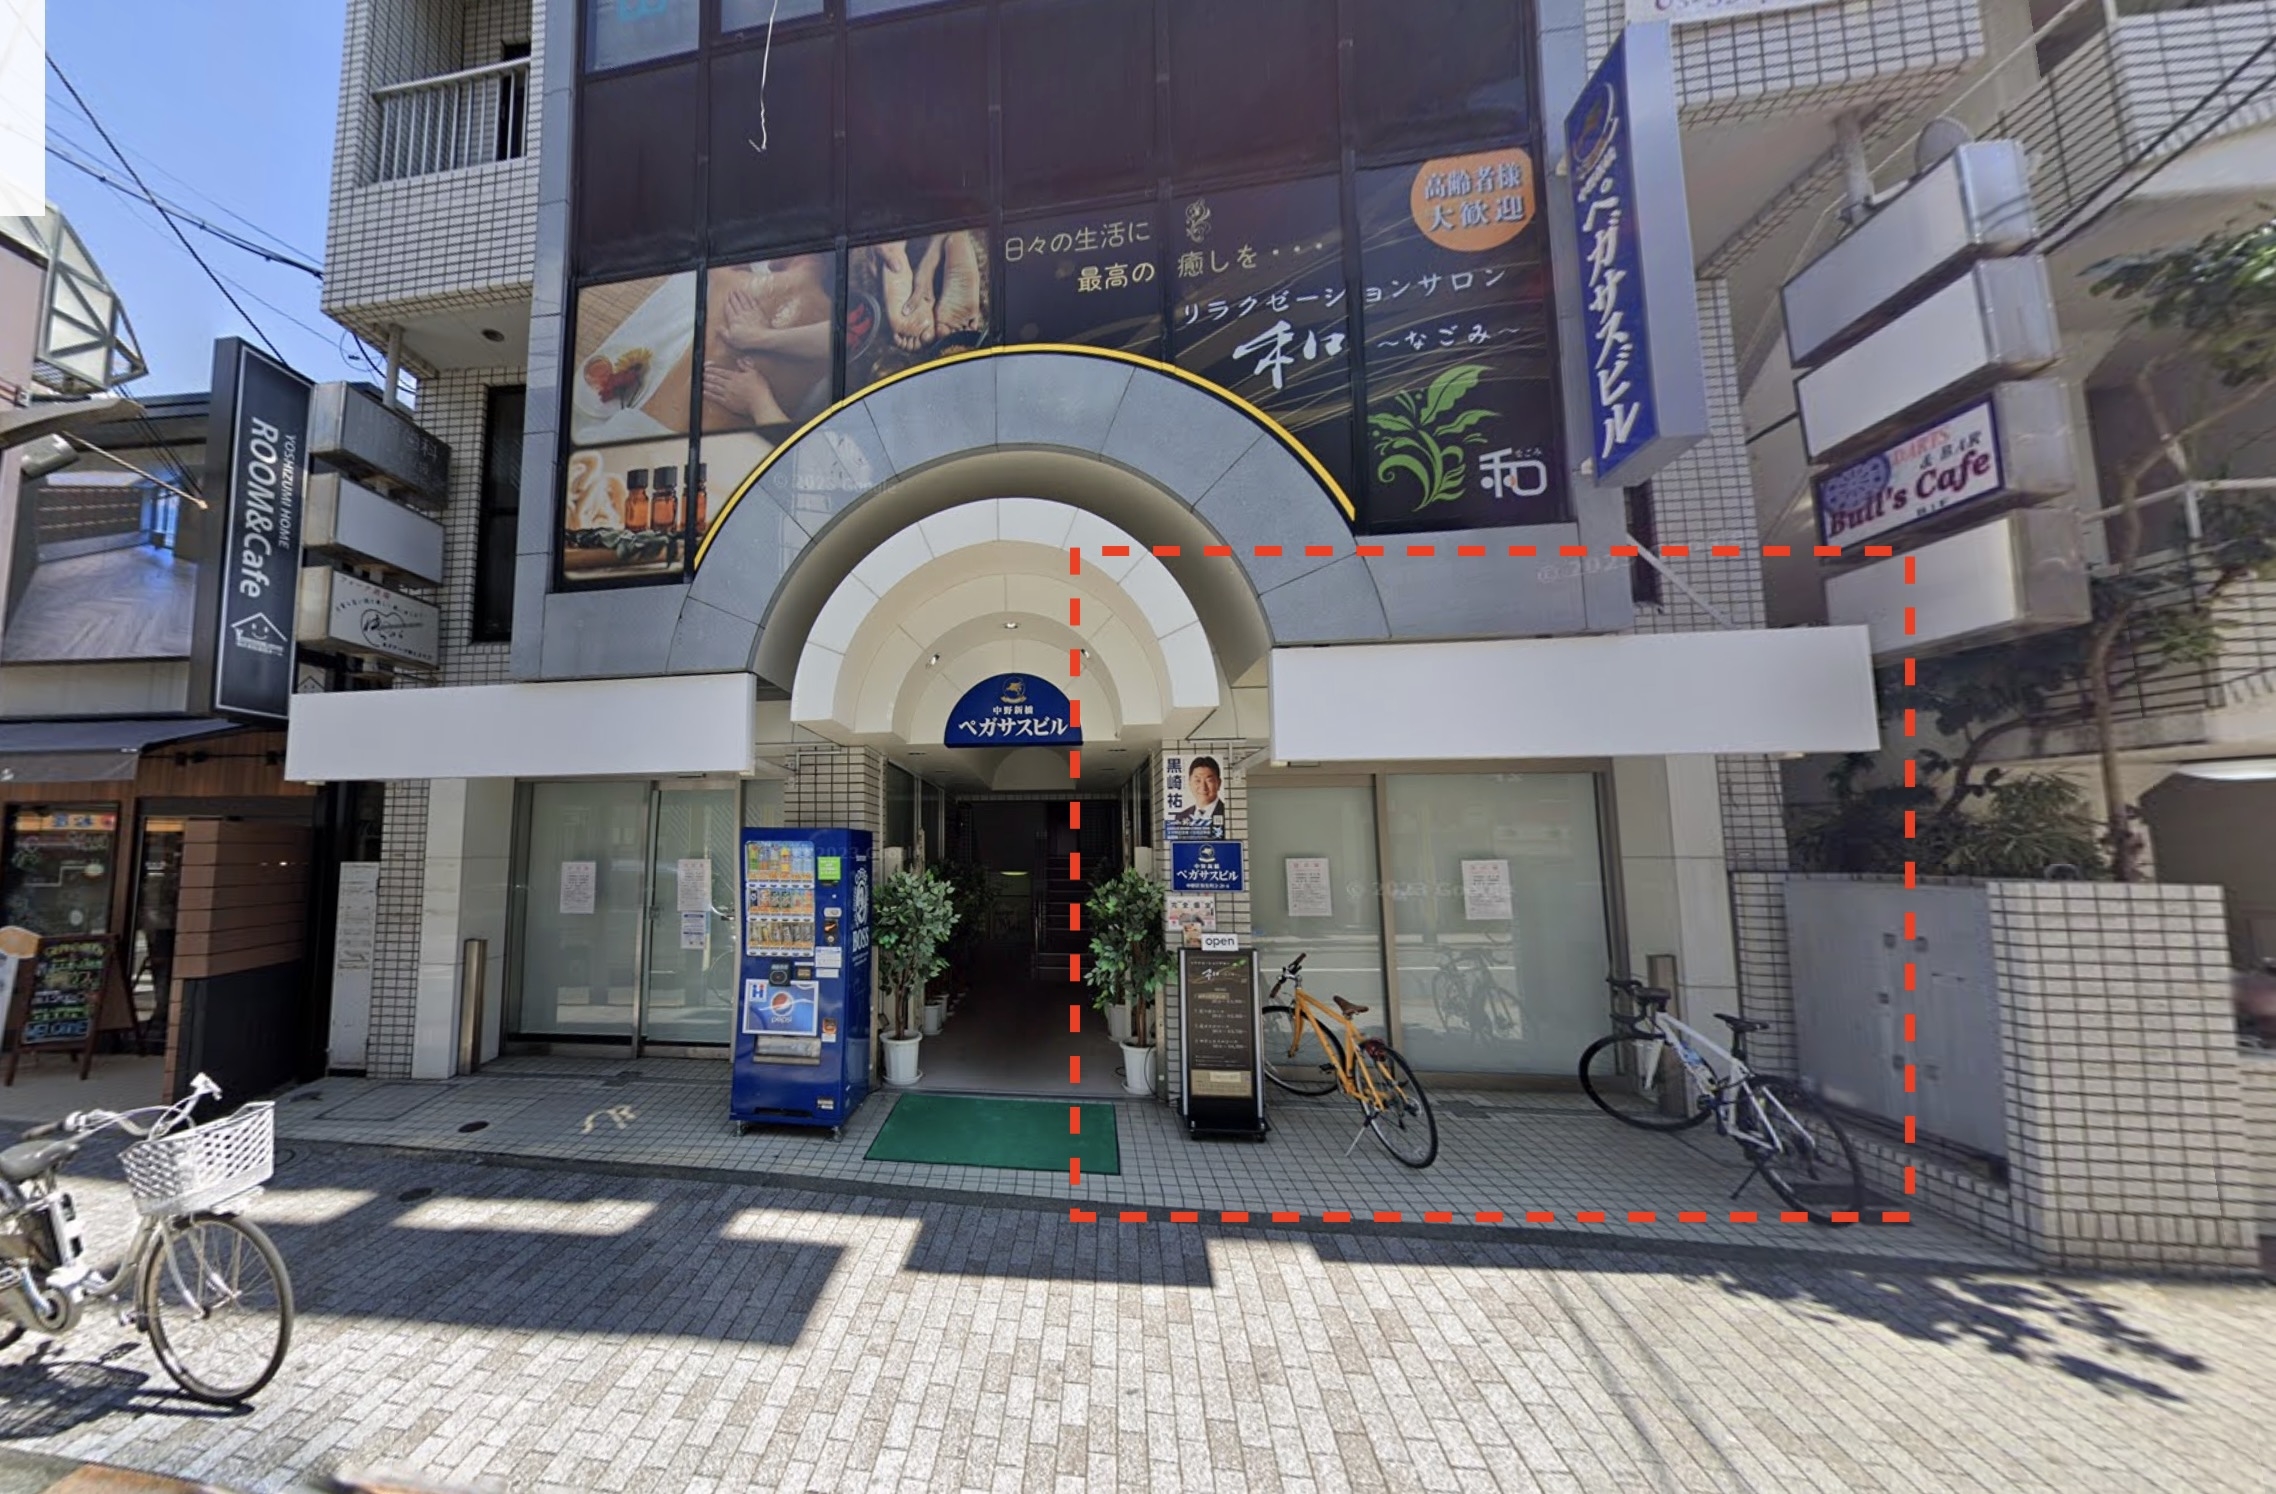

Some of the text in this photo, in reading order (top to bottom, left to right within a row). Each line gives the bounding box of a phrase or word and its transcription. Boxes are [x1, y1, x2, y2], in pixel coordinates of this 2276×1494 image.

[1424, 163, 1523, 200] 高齢者様
[1429, 203, 1526, 231] 大歓迎
[1005, 219, 1151, 262] 日々の生活に
[1077, 260, 1155, 293] 最高の
[1183, 267, 1506, 325] リラクゼーションサロン
[1232, 319, 1345, 389] 和
[1940, 429, 1983, 461] BAR
[1479, 447, 1548, 498] 和
[239, 416, 280, 598] ROOM&Cafe
[277, 434, 297, 550] YOSHIZUMI HOME
[1828, 449, 1991, 538] Bull's Cafe
[958, 715, 1069, 737] ペガサスビル
[992, 705, 1034, 715] 中野新橋
[1176, 868, 1238, 881] ペガサスビル
[852, 926, 869, 953] BOSS
[1205, 937, 1235, 947] open
[771, 1015, 793, 1024] pepsi
